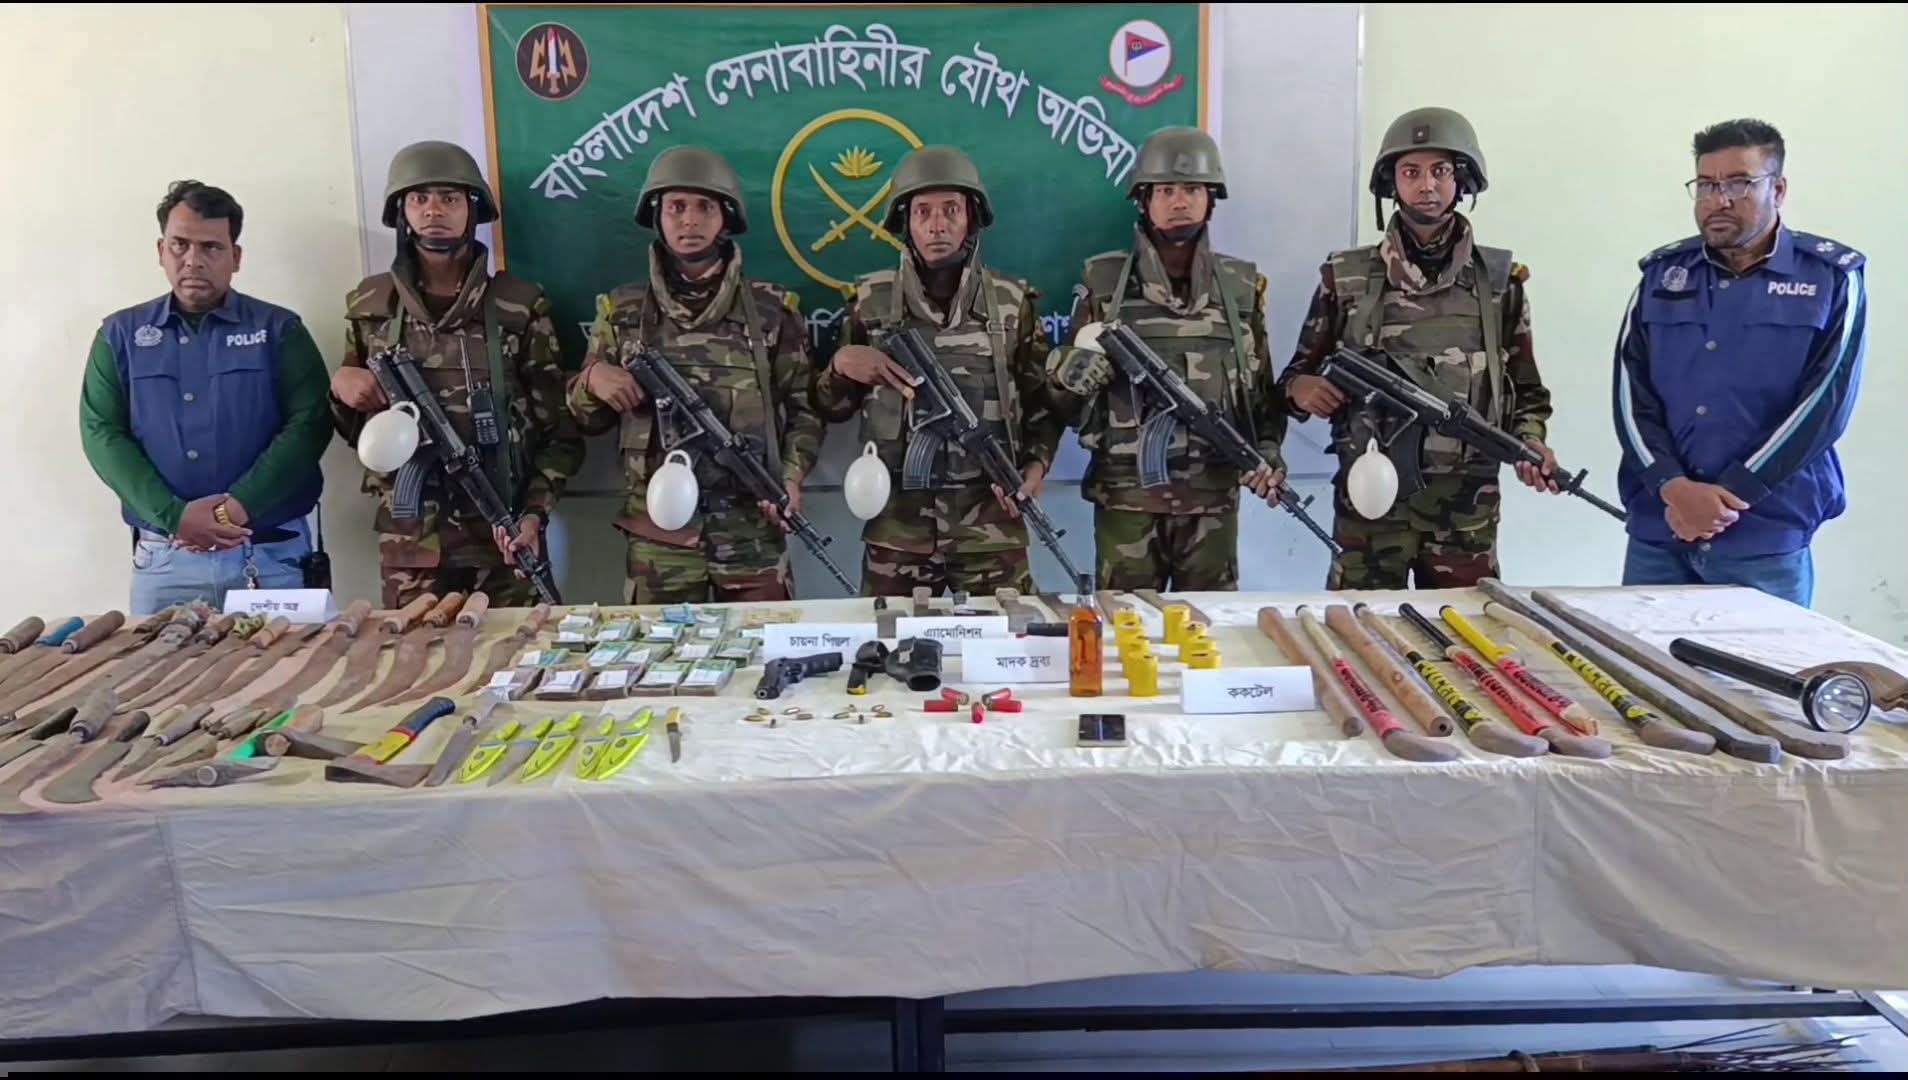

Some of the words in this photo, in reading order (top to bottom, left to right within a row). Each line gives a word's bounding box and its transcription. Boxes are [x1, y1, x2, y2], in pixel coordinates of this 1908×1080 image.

[529, 72, 697, 199] বাংলাদেশ
[705, 23, 931, 105] সেনাবাহিনীর
[941, 41, 1030, 118] যৌথ
[1037, 85, 1138, 187] অভিযা
[1767, 281, 1817, 296] POLICE
[226, 329, 268, 347] POLICE
[789, 636, 818, 647] চায়না
[995, 656, 1026, 668] মাদক
[1030, 655, 1051, 668] দ্রব্য
[1226, 683, 1275, 698] ককটেল
